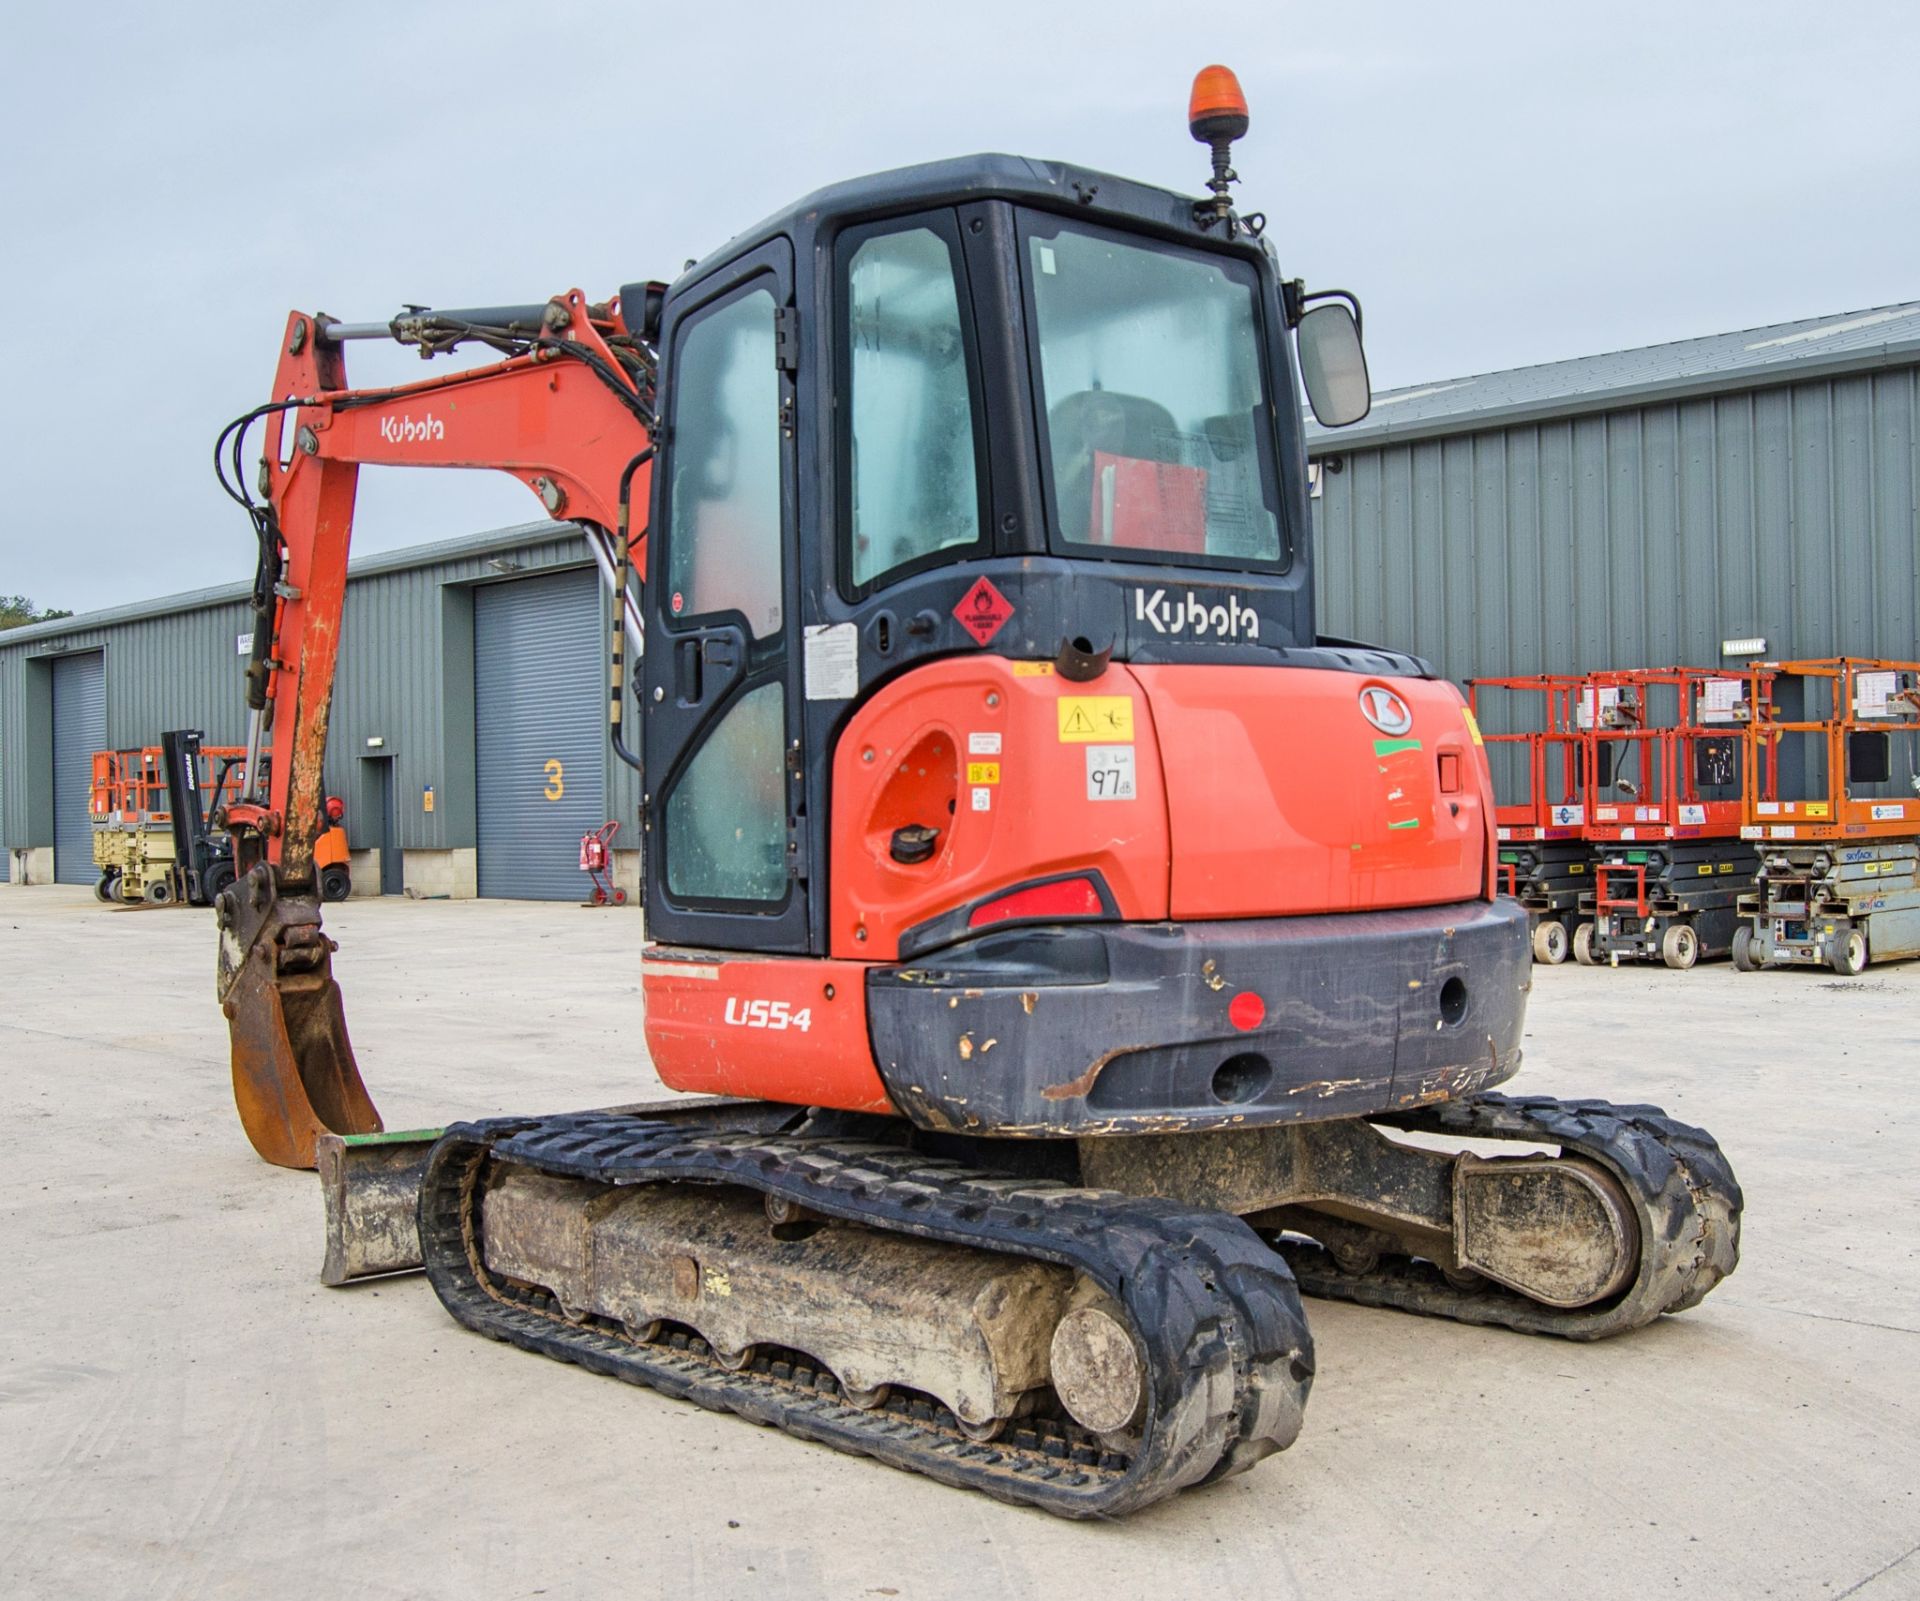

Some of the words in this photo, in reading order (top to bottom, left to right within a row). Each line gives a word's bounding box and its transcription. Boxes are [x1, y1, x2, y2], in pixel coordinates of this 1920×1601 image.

[381, 413, 444, 443] Kubota
[1135, 588, 1259, 638] Kubota
[185, 753, 195, 791] DOOSAN
[543, 758, 564, 801] 3
[1092, 769, 1120, 795] 97
[1846, 849, 1873, 861] SKYJACK
